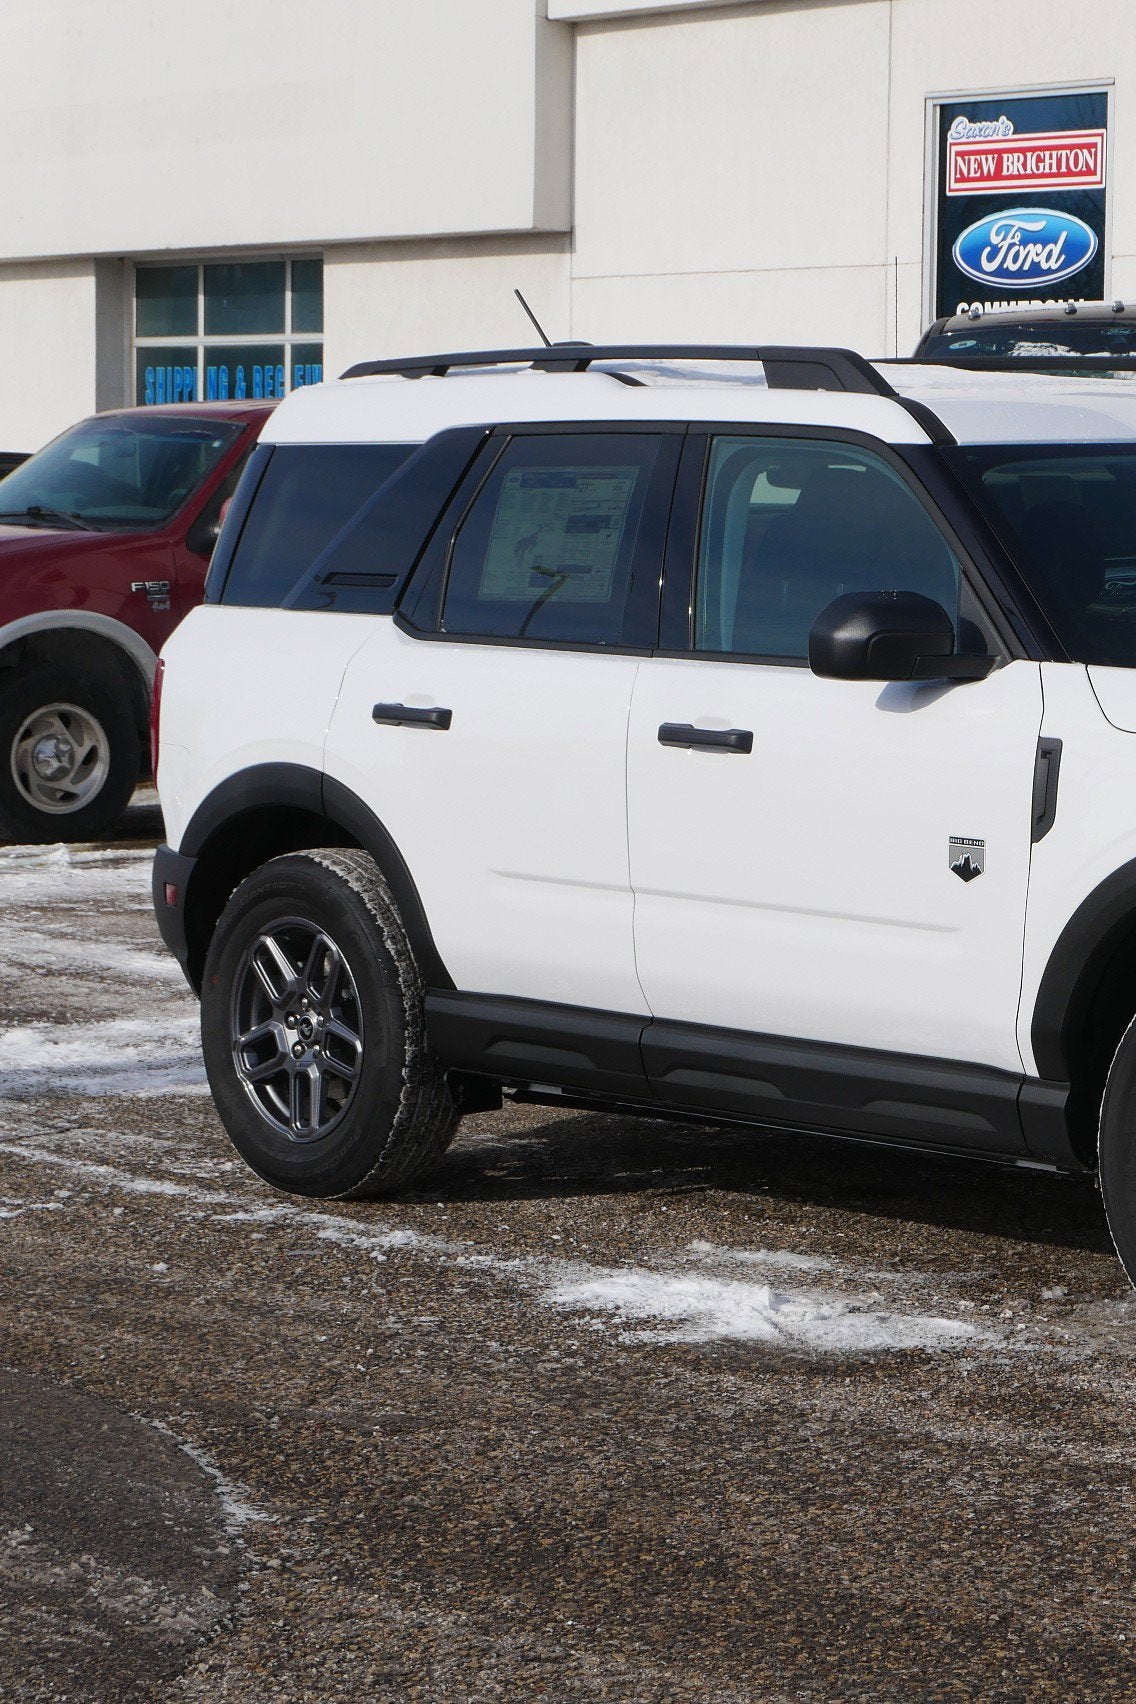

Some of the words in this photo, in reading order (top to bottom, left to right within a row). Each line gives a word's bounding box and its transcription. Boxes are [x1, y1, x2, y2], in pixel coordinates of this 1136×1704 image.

[949, 118, 1013, 140] Saxon's
[955, 153, 998, 178] NEW
[1001, 148, 1096, 176] BRIGHTON
[980, 219, 1069, 272] Ford
[145, 366, 229, 406] SHIPPING
[235, 364, 246, 401] &
